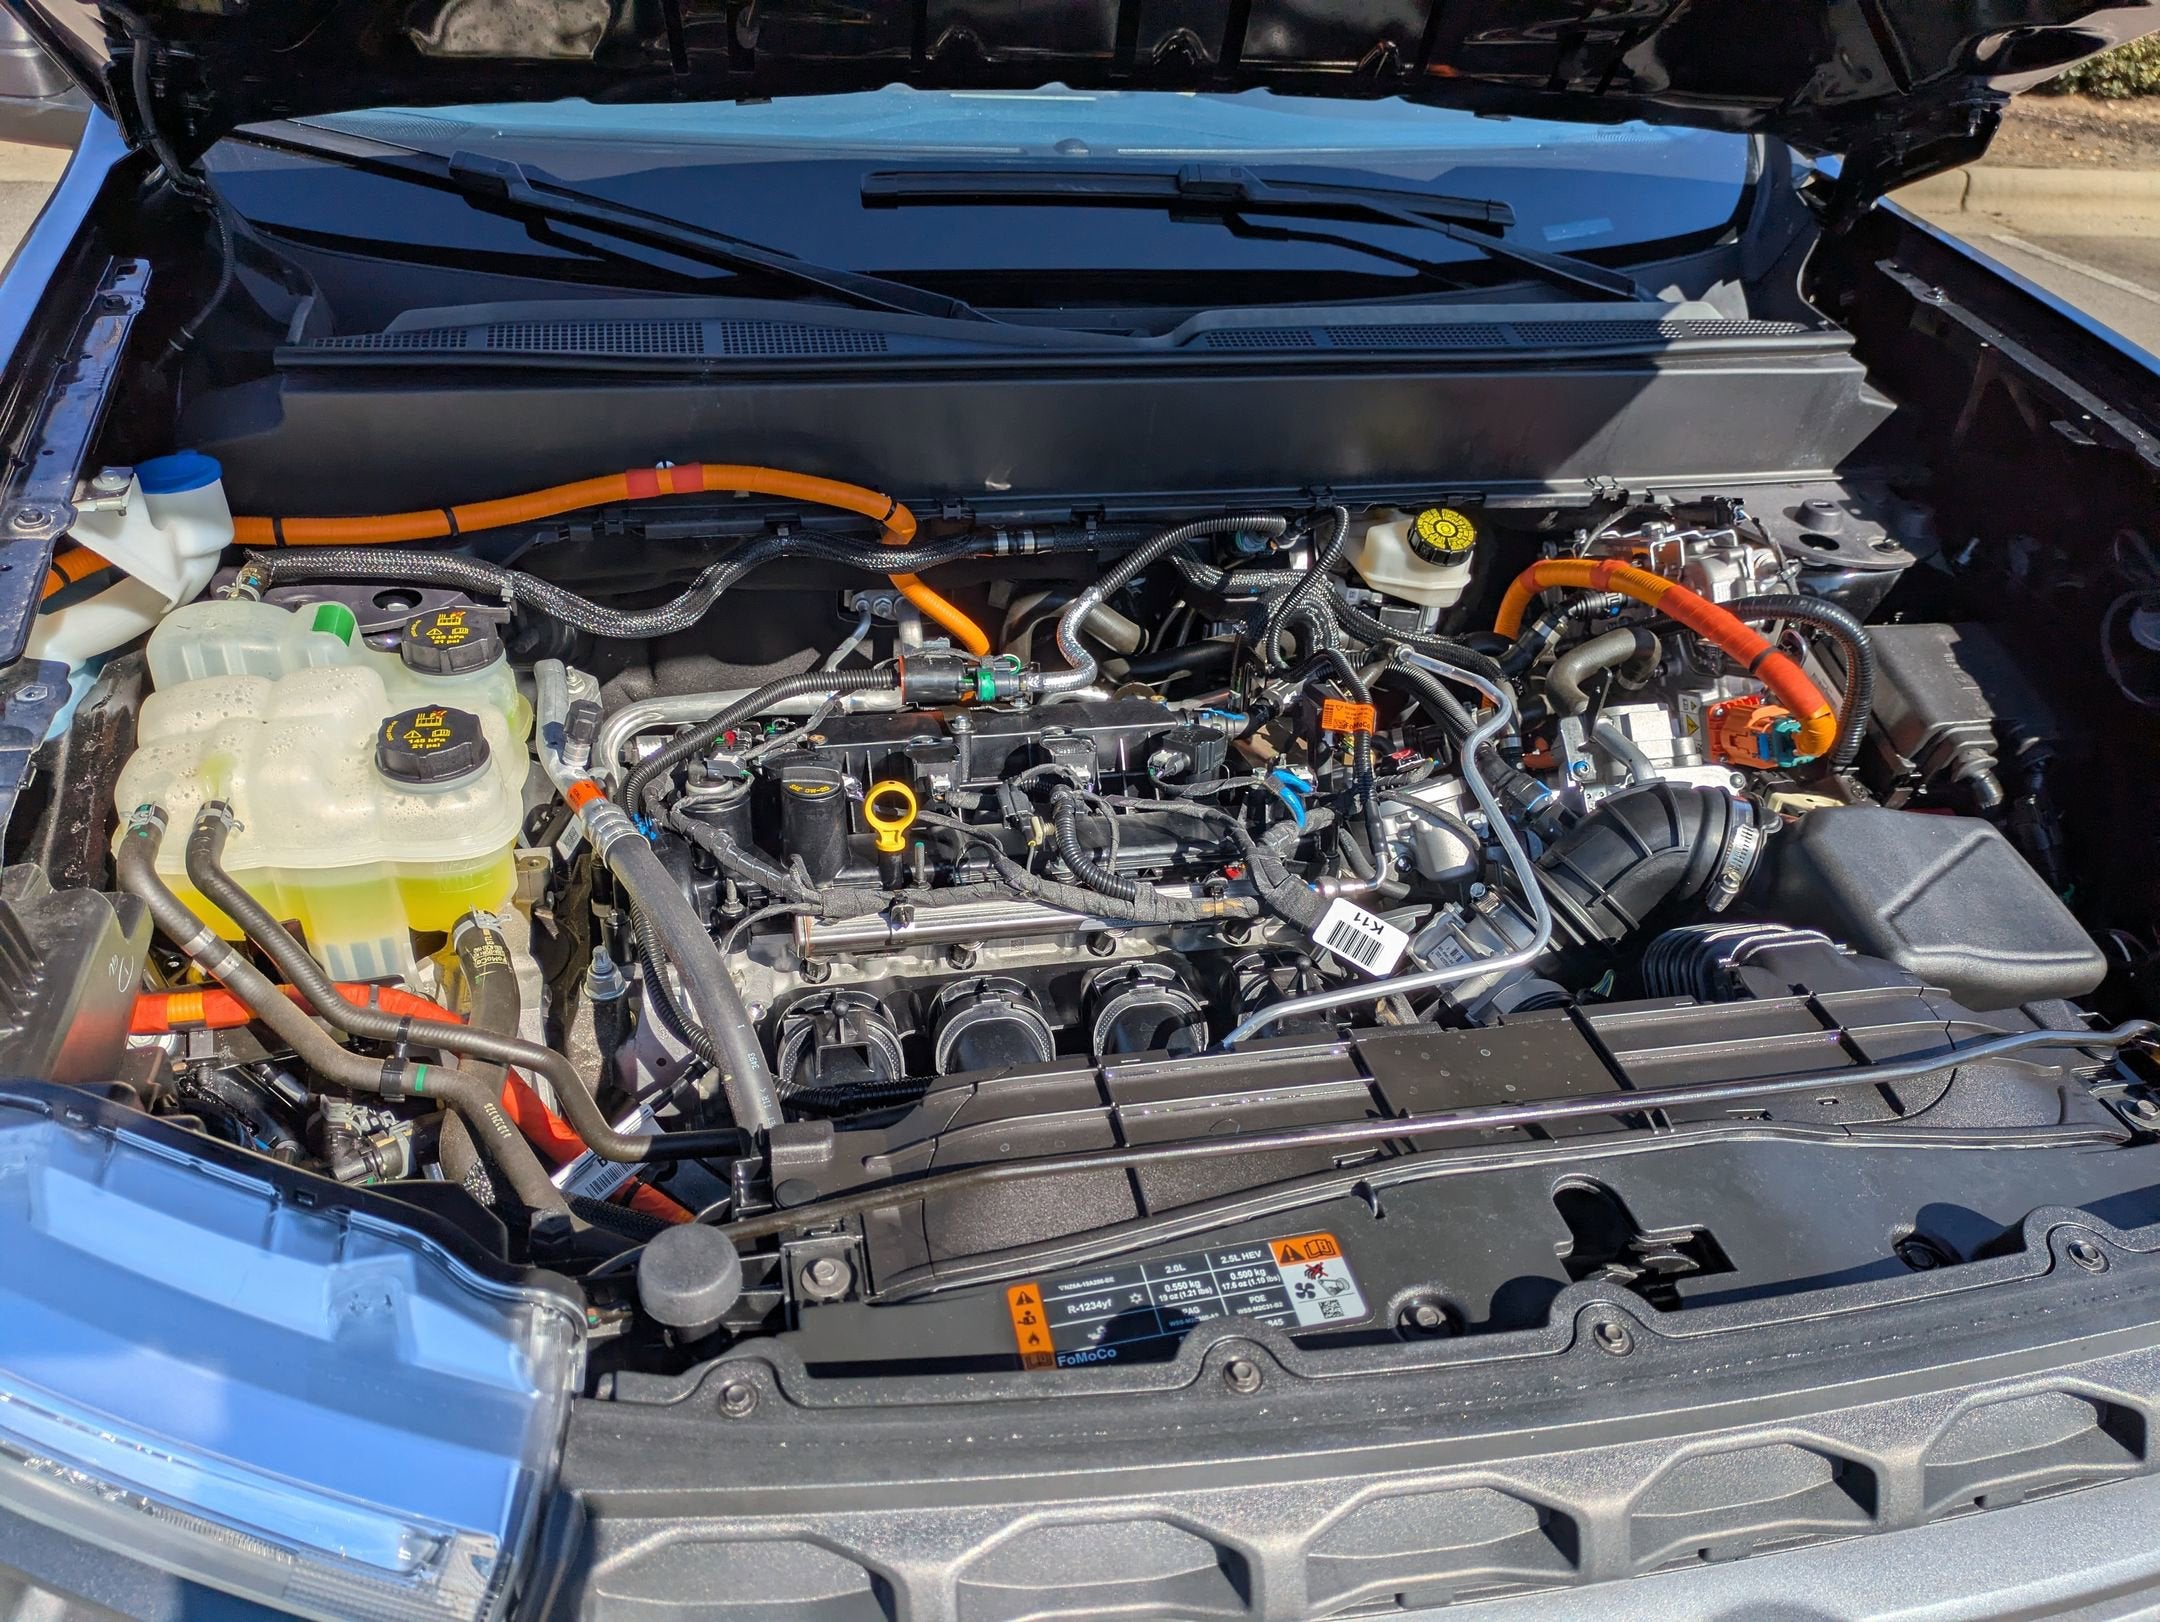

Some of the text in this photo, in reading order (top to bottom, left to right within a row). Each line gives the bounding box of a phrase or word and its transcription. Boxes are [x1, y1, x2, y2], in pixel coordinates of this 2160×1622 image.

[1353, 912, 1384, 935] K11
[1220, 1250, 1262, 1264] 2.5L HEV
[1165, 1264, 1187, 1274] 2.0L
[1229, 1268, 1267, 1280] 0.500 kg
[1164, 1280, 1201, 1292] 0.550 kg
[1158, 1294, 1168, 1302] 19
[1179, 1289, 1197, 1300] (1.21
[1198, 1286, 1213, 1296] lbs)
[1248, 1295, 1267, 1304] POE
[1067, 1298, 1112, 1314] R-1234yf
[1056, 1348, 1117, 1367] FoMoCo
